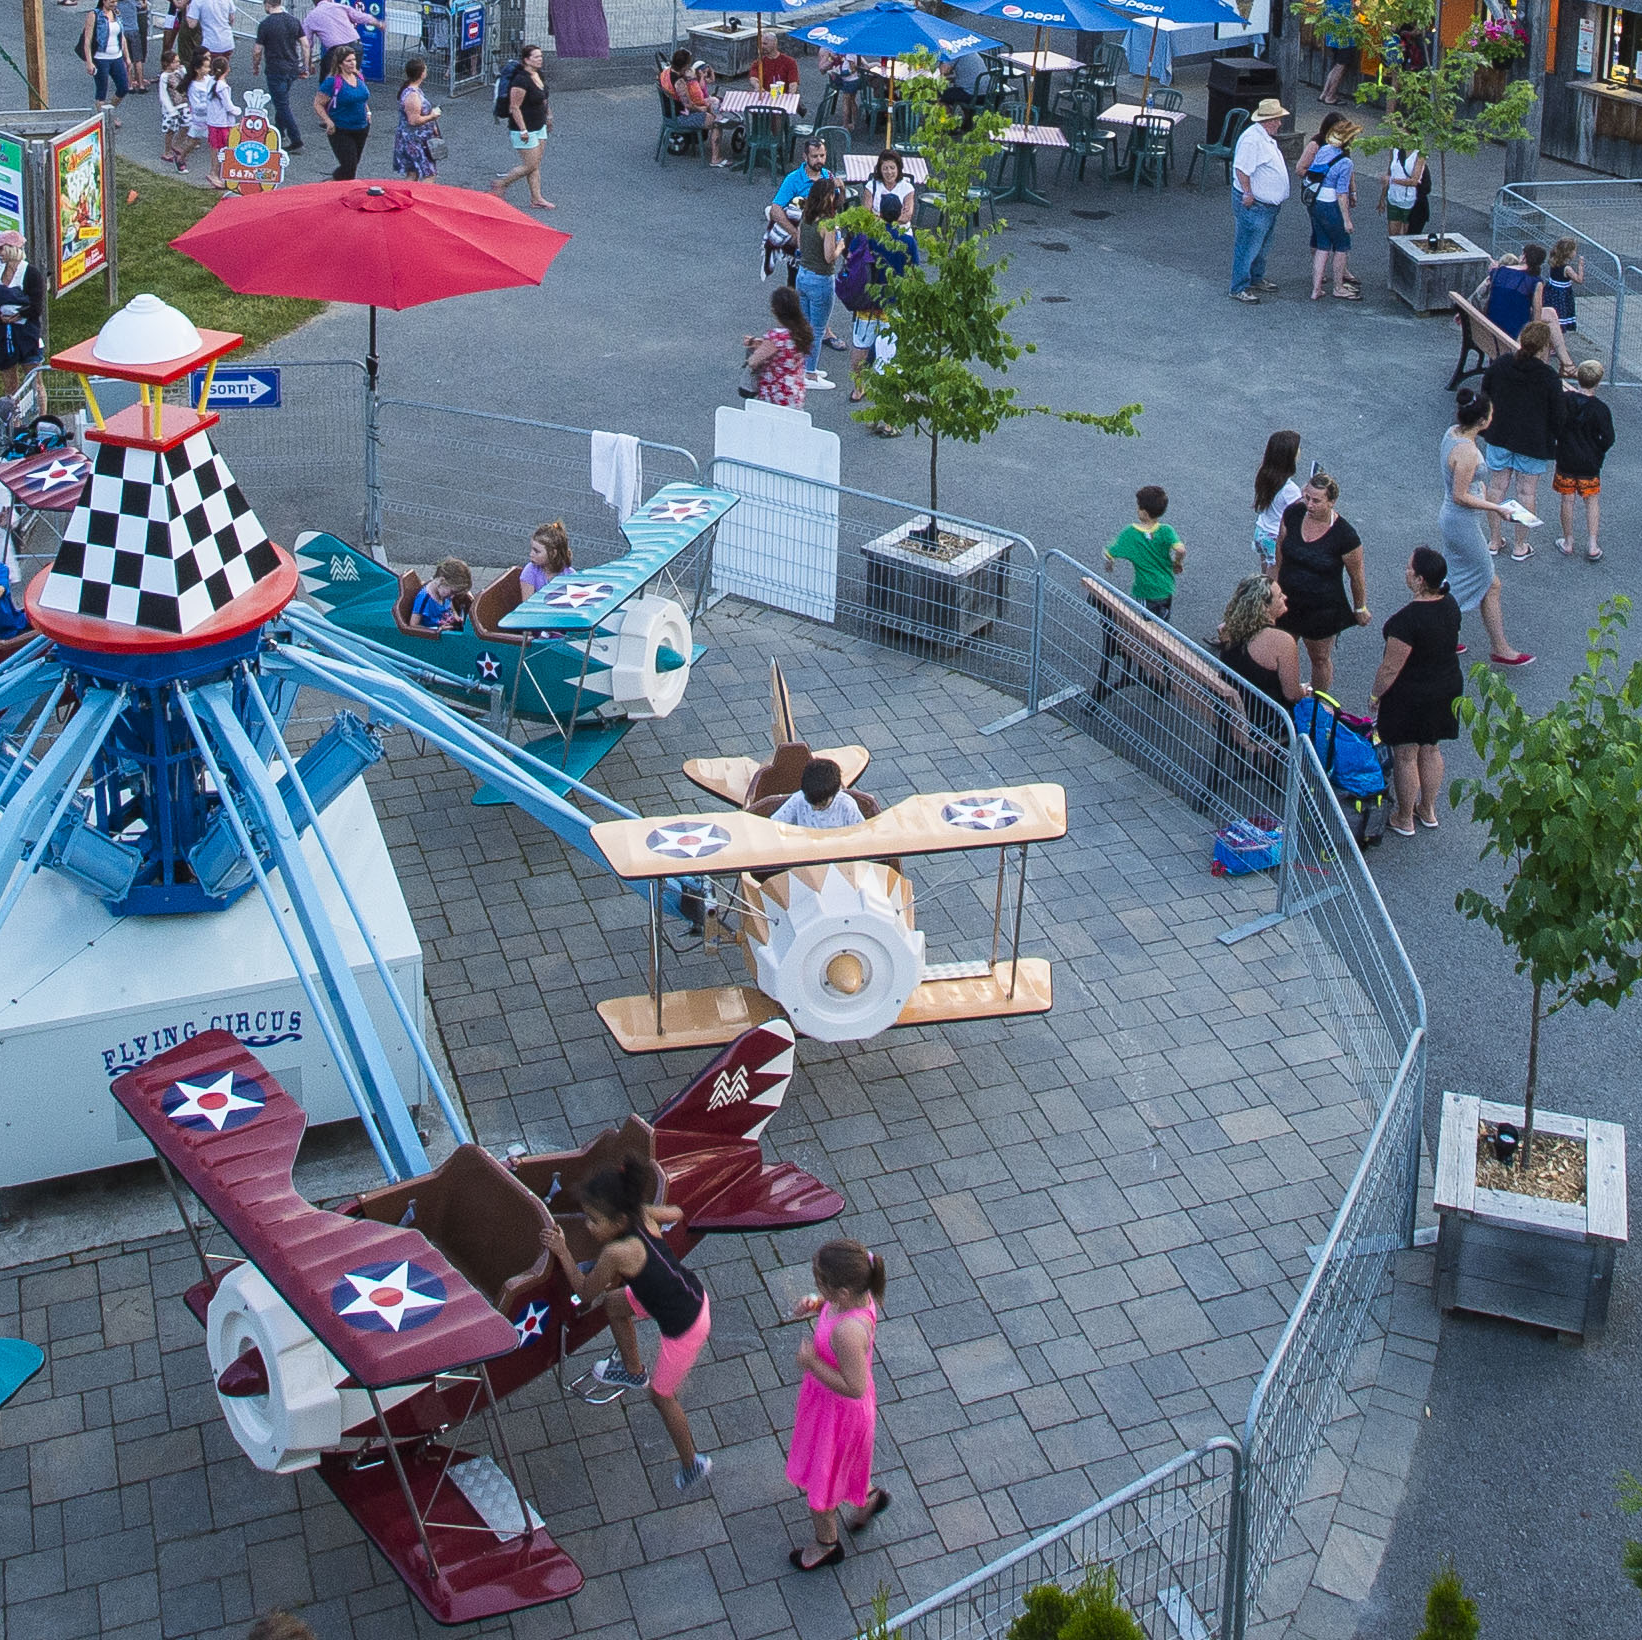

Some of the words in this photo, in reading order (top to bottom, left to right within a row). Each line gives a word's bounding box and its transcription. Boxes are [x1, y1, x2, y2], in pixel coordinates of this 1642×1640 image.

[1023, 10, 1066, 23] pepsi
[951, 34, 982, 53] pepsi
[209, 384, 257, 395] SORTIE
[101, 1021, 199, 1071] FLYING
[210, 1010, 303, 1034] CIRCUS
